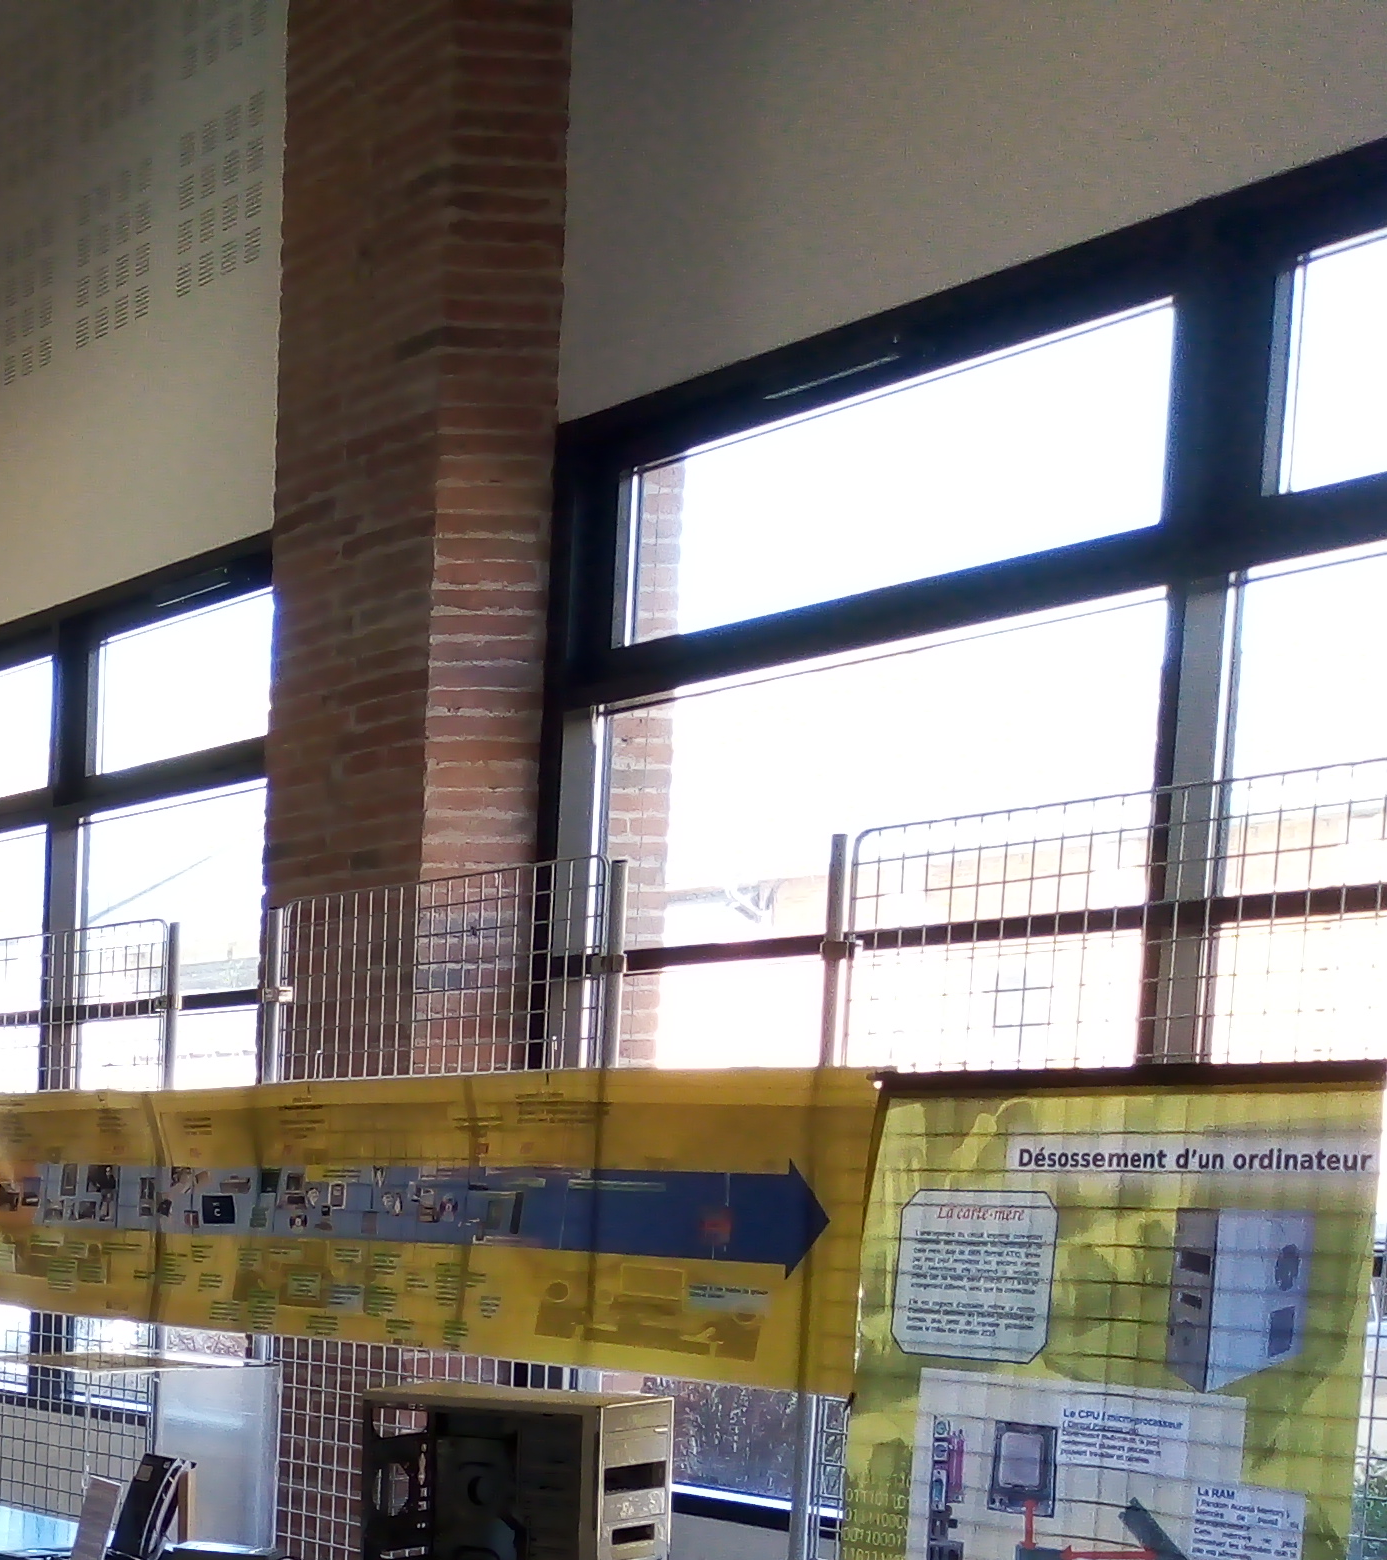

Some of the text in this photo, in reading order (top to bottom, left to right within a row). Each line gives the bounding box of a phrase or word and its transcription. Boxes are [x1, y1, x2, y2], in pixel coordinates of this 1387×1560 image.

[1018, 1147, 1373, 1173] Désossement d'un ordinateur
[1063, 1408, 1076, 1419] Le
[1078, 1410, 1100, 1421] CPU
[1211, 1488, 1235, 1500] RAM
